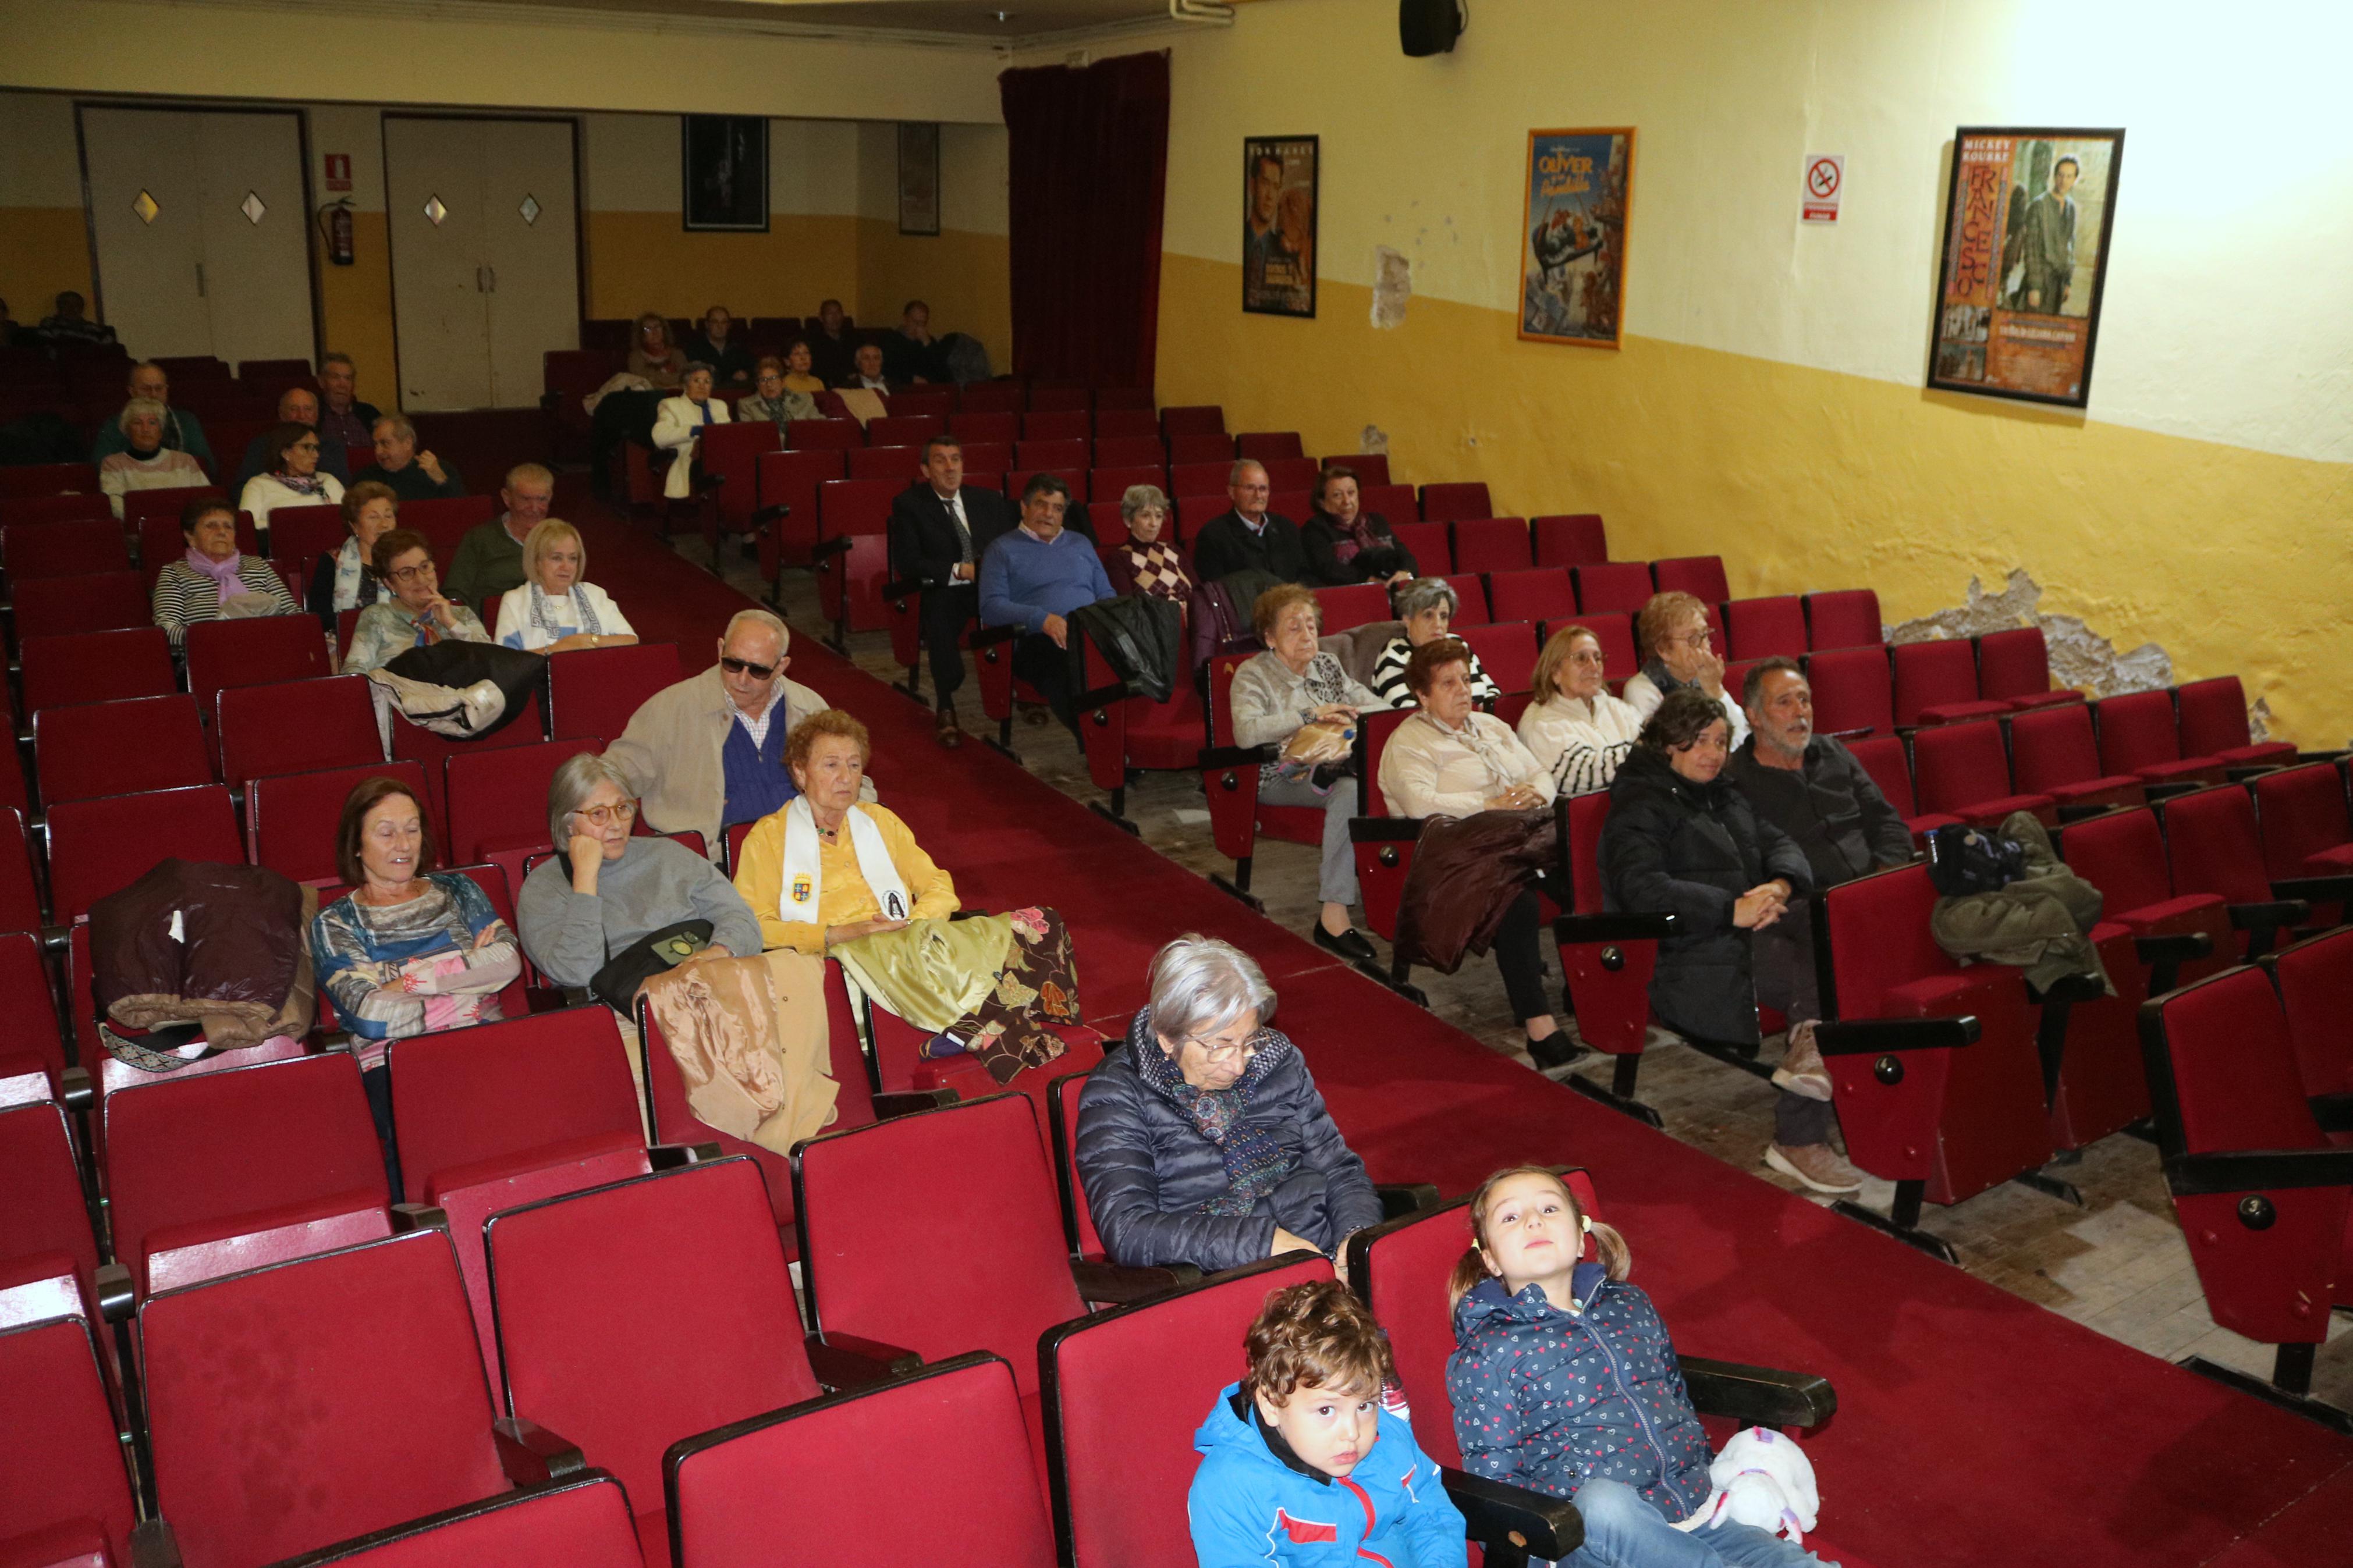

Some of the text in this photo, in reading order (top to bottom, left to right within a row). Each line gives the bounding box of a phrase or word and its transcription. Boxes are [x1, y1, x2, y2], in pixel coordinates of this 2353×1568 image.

[1964, 139, 2011, 150] MICKEY
[1538, 151, 1593, 173] OLIVER
[1961, 151, 2010, 162] ROURKE
[2248, 1199, 2259, 1213] 3
